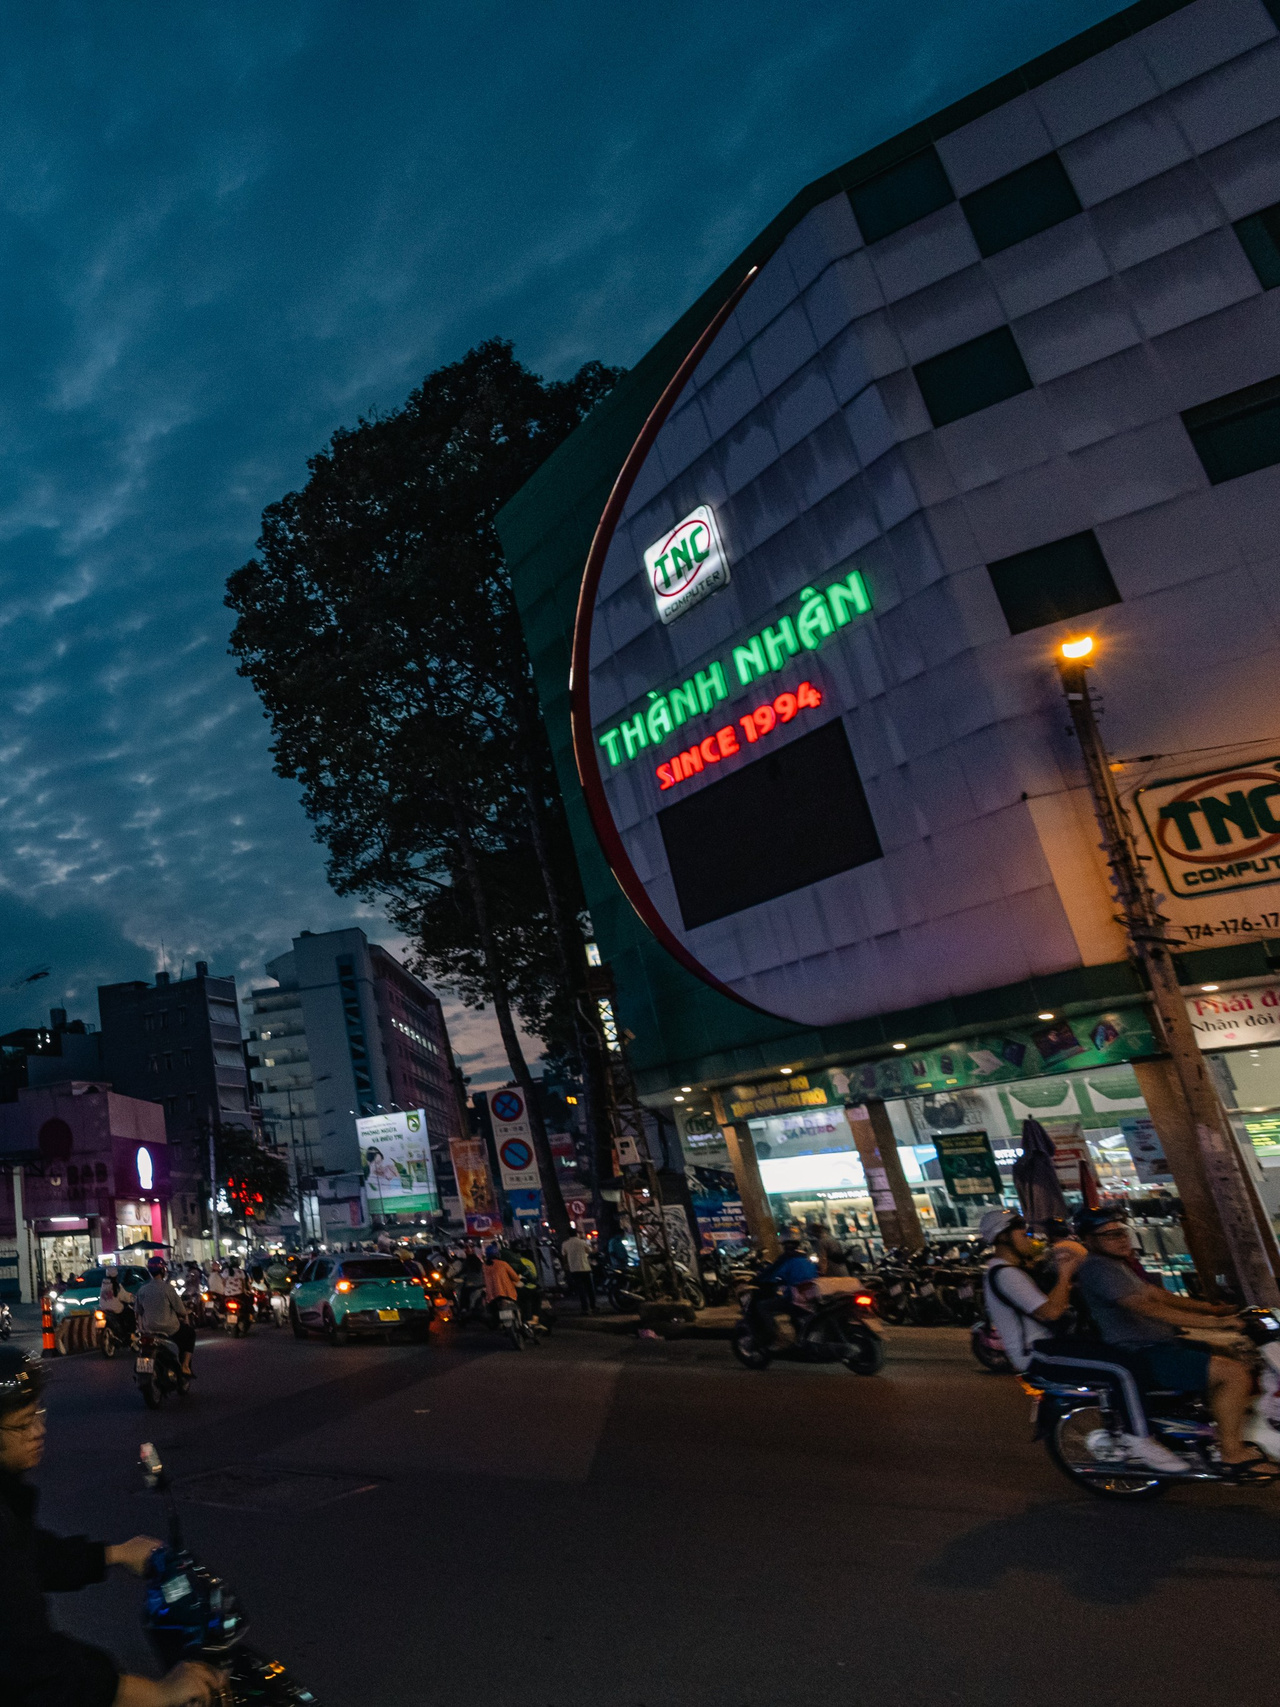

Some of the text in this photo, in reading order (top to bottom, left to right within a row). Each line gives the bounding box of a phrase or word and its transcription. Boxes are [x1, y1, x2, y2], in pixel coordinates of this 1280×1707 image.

[654, 525, 710, 589] TNC
[664, 570, 720, 617] COMPUTER
[599, 569, 873, 767] THÀNH NHÂN
[656, 681, 822, 791] SINCE 1994
[1245, 1012, 1275, 1027] đôi
